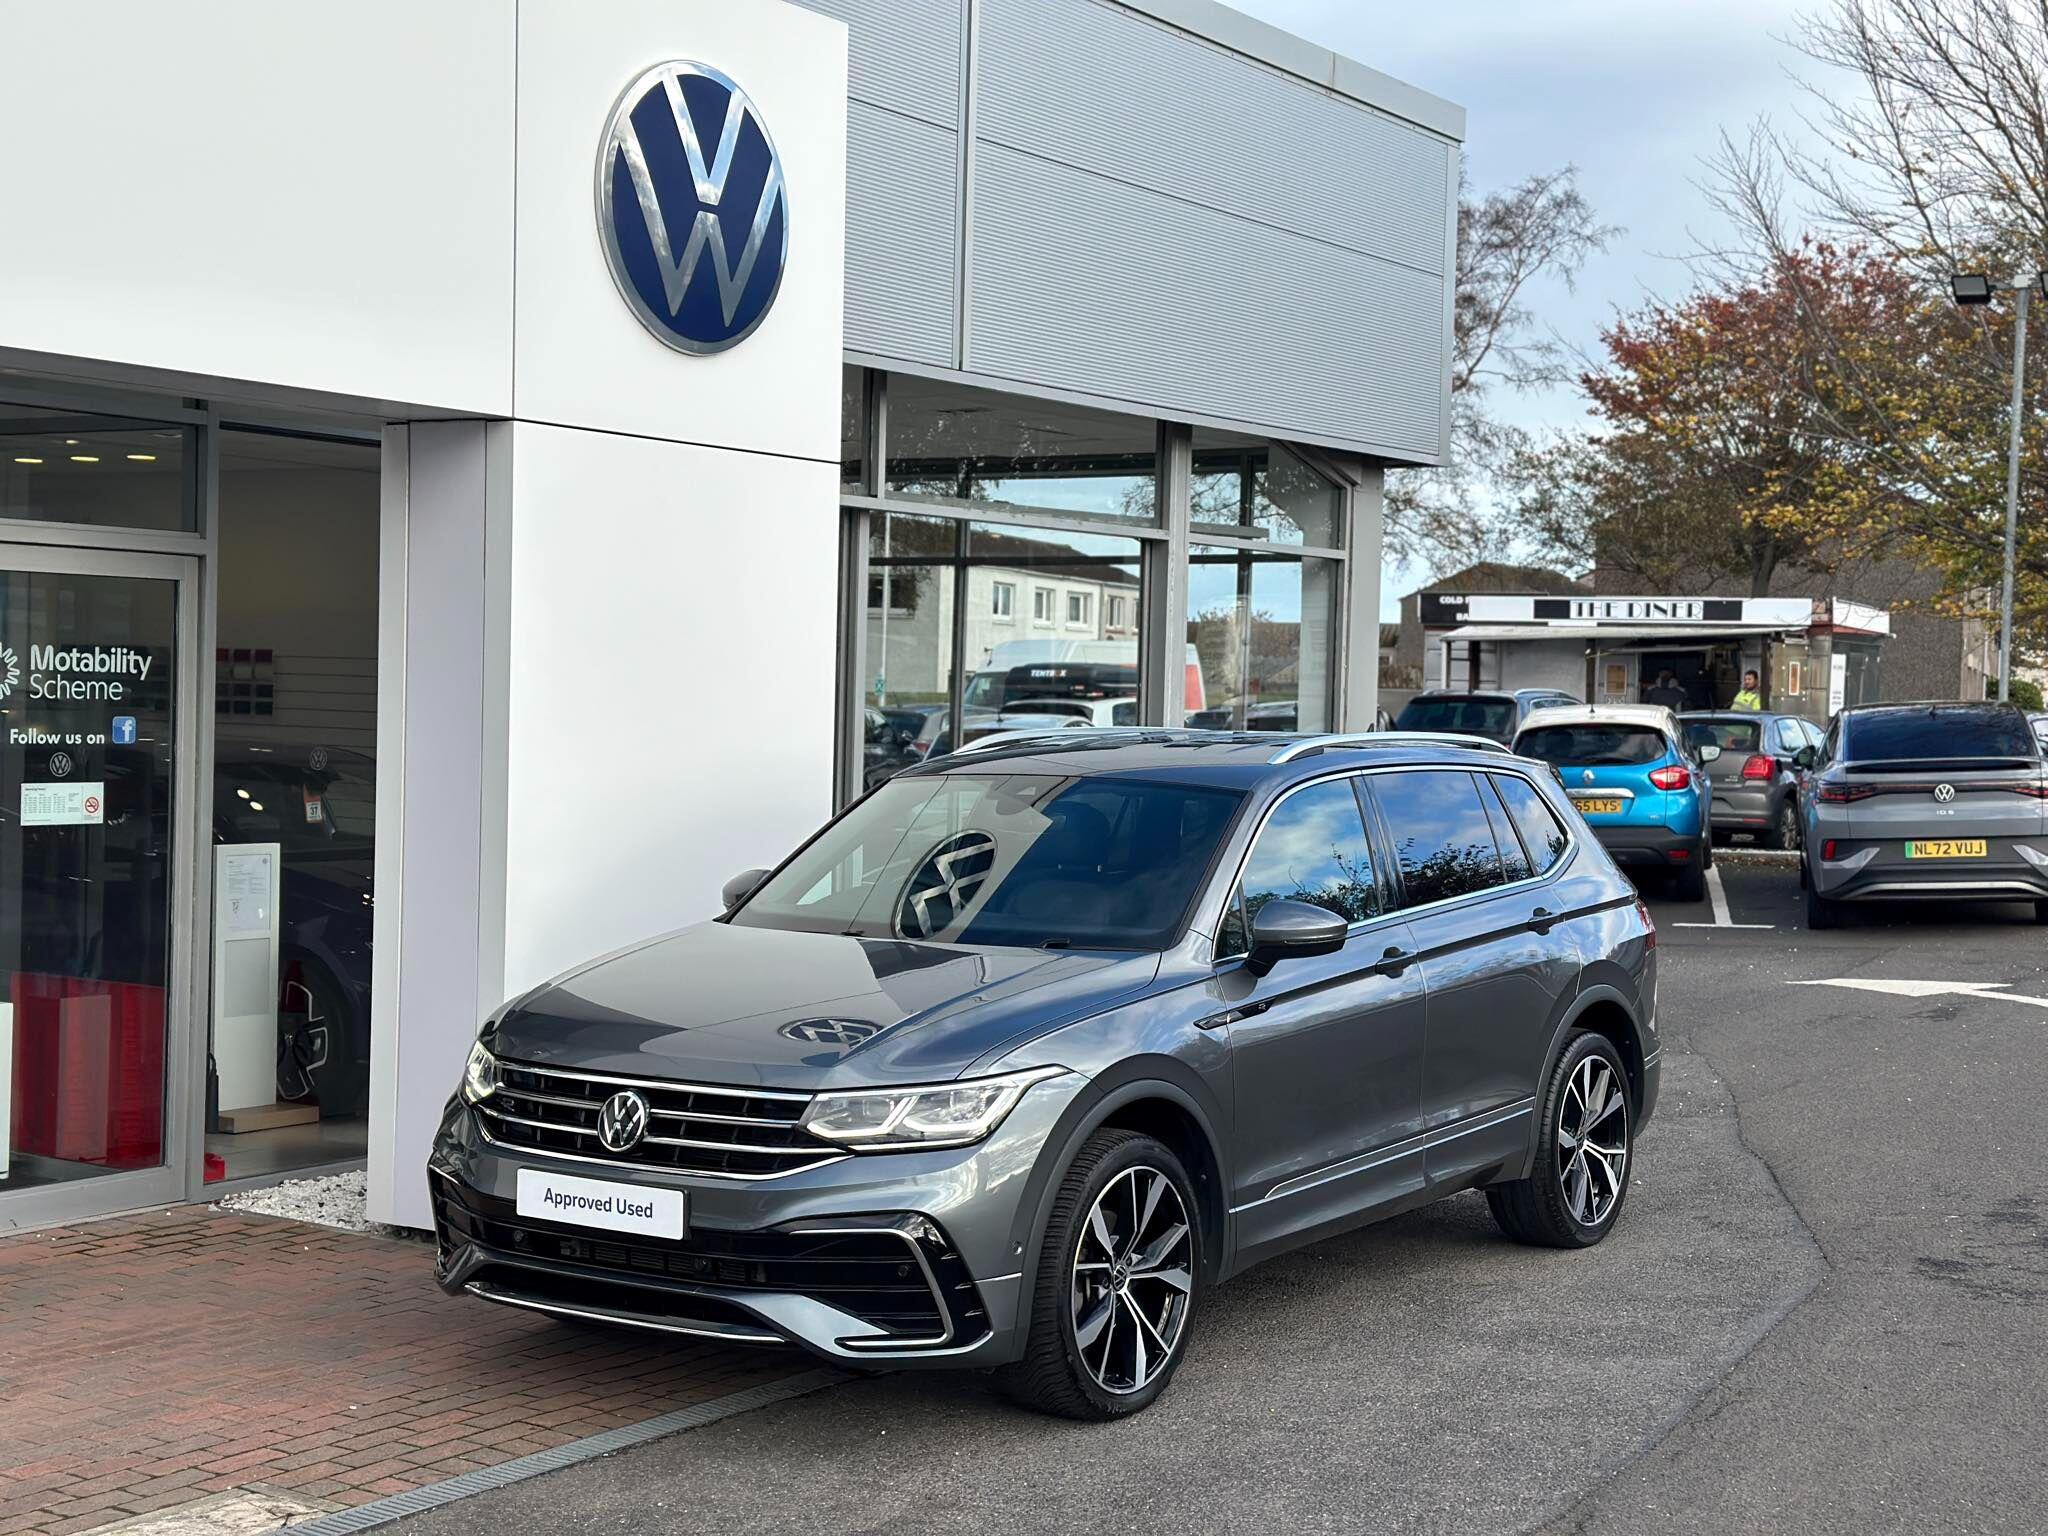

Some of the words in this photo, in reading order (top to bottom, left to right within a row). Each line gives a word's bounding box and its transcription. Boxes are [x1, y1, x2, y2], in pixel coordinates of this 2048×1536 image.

[1440, 596, 1463, 604] COLD
[1572, 601, 1619, 618] THE
[1627, 602, 1703, 618] DINER
[30, 644, 152, 681] Motability
[29, 673, 123, 700] Scheme
[10, 728, 61, 744] Follow
[65, 733, 82, 744] us
[86, 733, 105, 744] on
[1593, 800, 1617, 811] LYS
[1914, 843, 1951, 855] NL72
[1955, 842, 1983, 854] VUJ
[543, 1187, 612, 1213] Approved
[616, 1197, 653, 1219] Used
